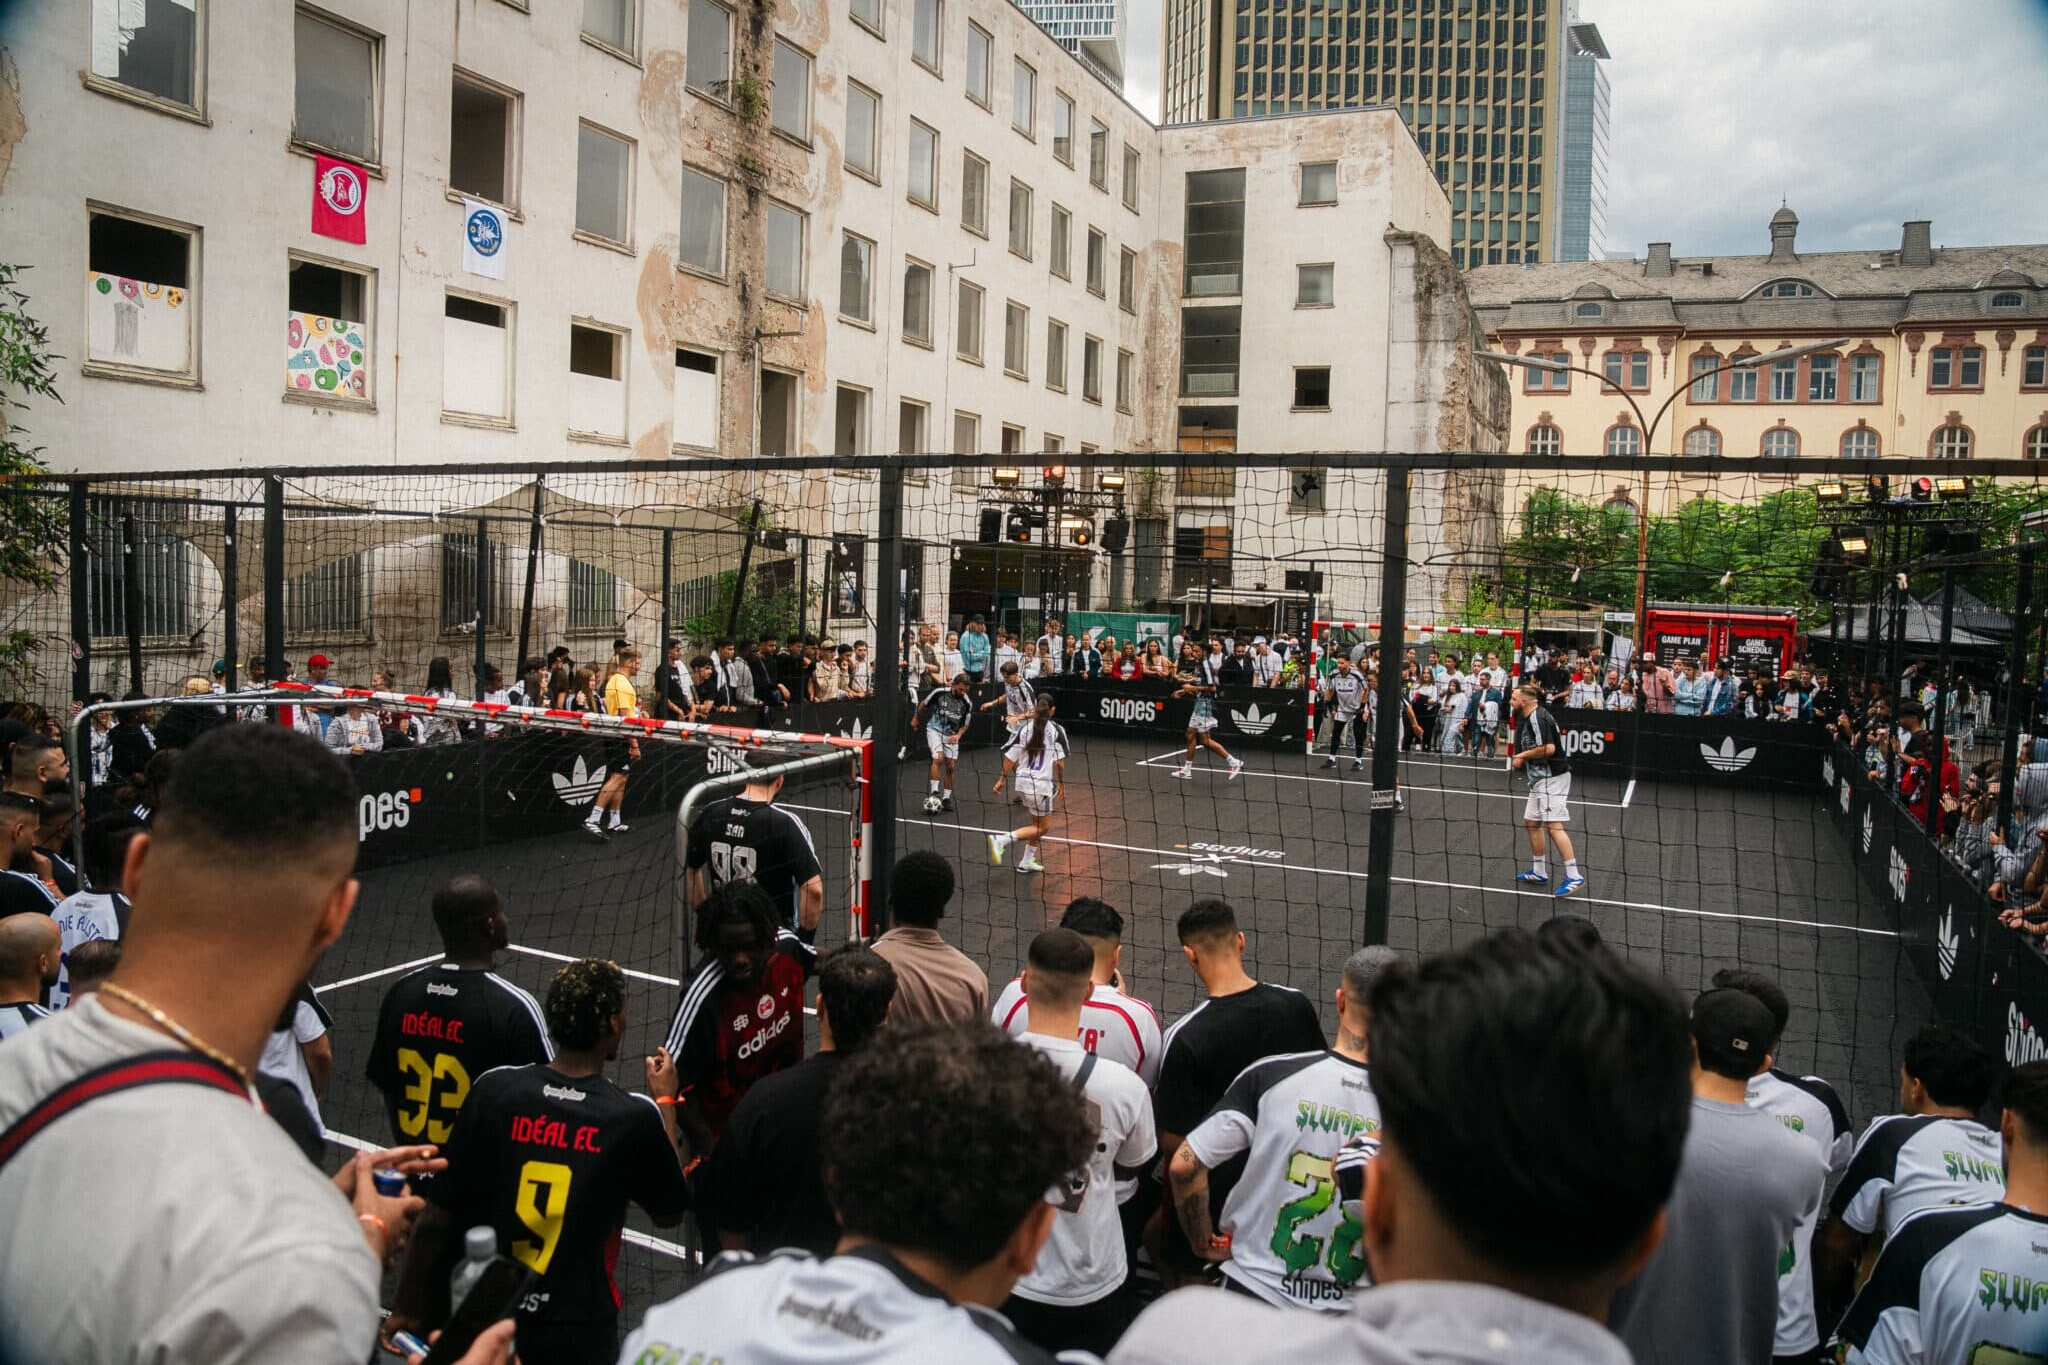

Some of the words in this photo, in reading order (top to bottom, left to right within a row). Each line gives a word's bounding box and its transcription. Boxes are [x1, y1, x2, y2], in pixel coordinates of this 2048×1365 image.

[1661, 635, 1681, 645] GAME
[1683, 637, 1702, 646] PLAN
[1737, 645, 1773, 655] SCHEDULE
[1745, 638, 1766, 647] GAME
[1100, 697, 1155, 724] snipes
[1560, 728, 1605, 757] ipes
[359, 789, 410, 842] pes
[725, 823, 745, 838] SAN
[402, 1011, 444, 1039] IDÉAL
[737, 1010, 791, 1060] adidas
[397, 1047, 472, 1144] 33
[511, 1114, 568, 1149] IDÉAL
[1943, 1150, 2007, 1188] SLUM
[511, 1160, 573, 1276] 9
[1281, 1278, 1344, 1304] snipes
[1978, 1267, 2048, 1315] SLUM
